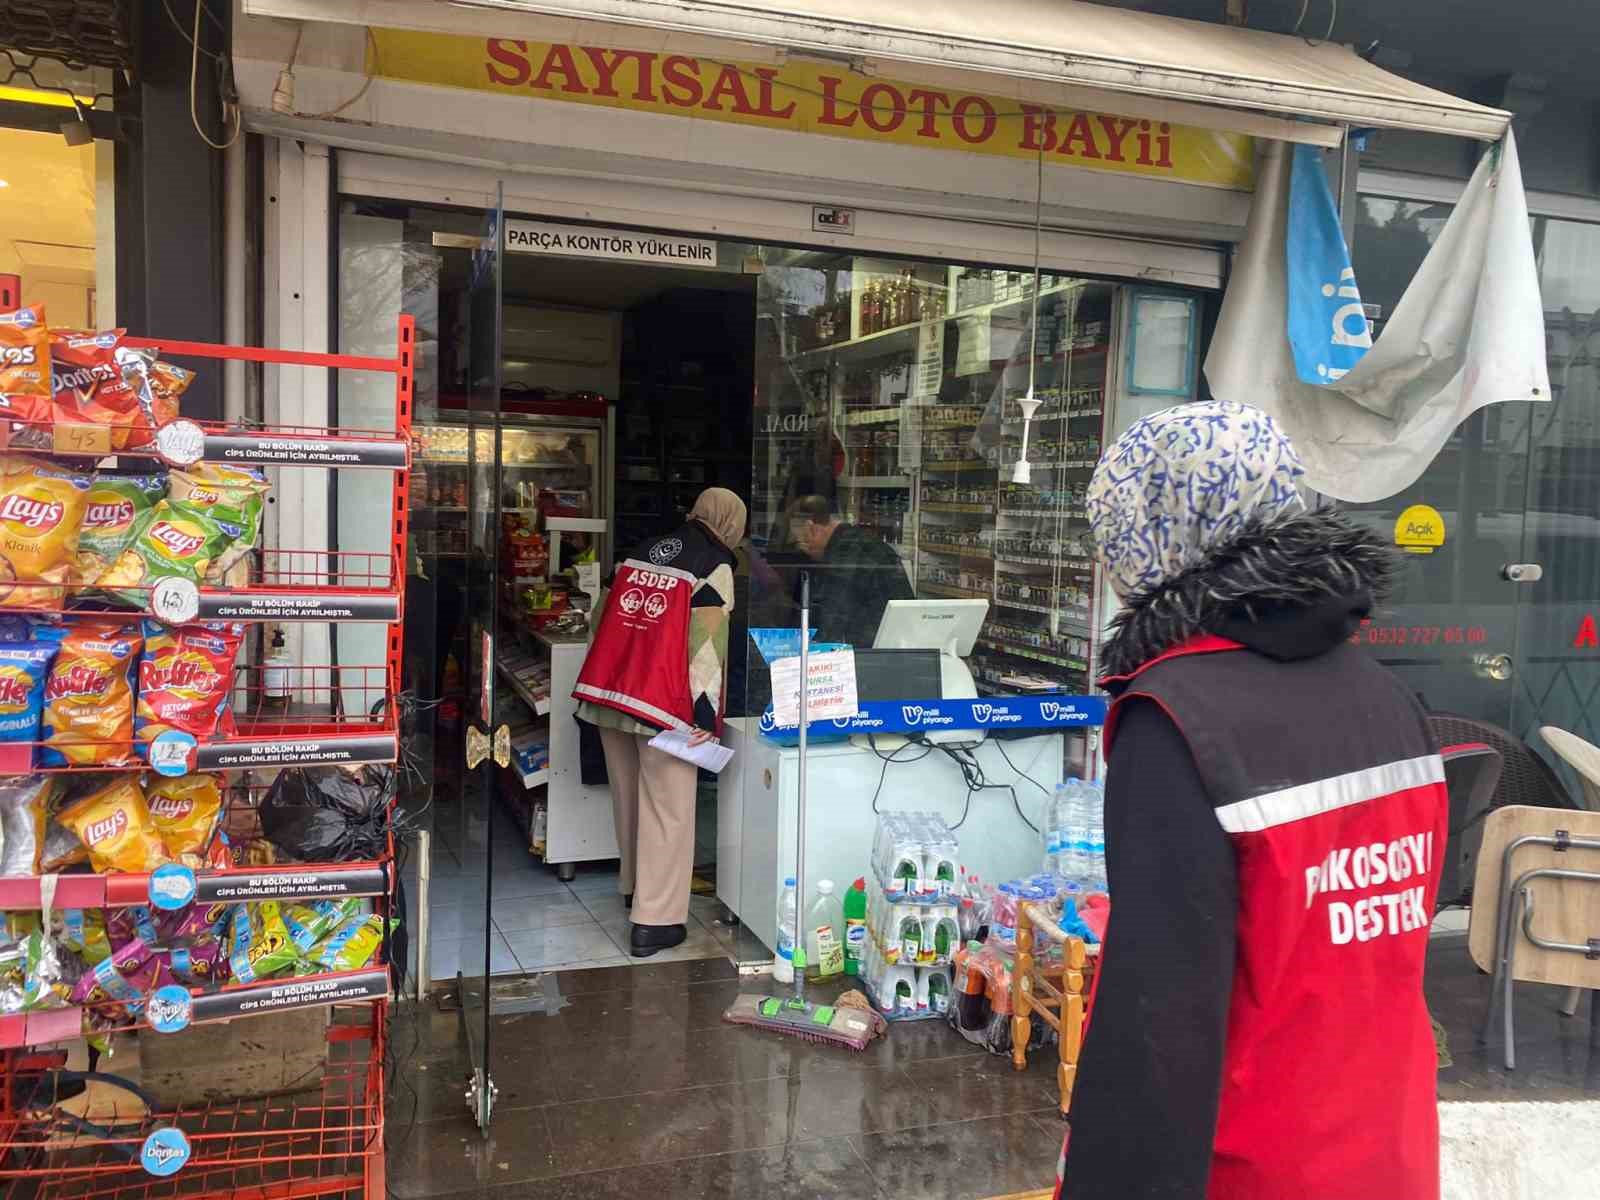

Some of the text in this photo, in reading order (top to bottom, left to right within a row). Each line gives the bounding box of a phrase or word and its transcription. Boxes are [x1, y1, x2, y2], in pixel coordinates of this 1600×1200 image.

[485, 37, 797, 120] SAYISAL
[817, 75, 997, 145] LOTO
[508, 229, 712, 261] PARÇA KONTÖR YÜKLENİR
[258, 442, 271, 450] BU
[273, 442, 302, 451] BÖLÜM
[224, 449, 244, 458] CİPS
[290, 451, 307, 461] İÇİN
[1, 495, 63, 528] Lay's
[151, 524, 204, 554] Lay's
[5, 540, 41, 554] Klasik
[627, 569, 678, 590] ASDEP
[251, 599, 264, 607] BU
[264, 599, 294, 608] BÖLÜM
[218, 607, 237, 616] CİPS
[239, 607, 281, 616] ÜRÜNLERİ
[282, 608, 299, 617] İÇİN
[1060, 705, 1075, 713] milli
[923, 716, 954, 725] piyango
[993, 714, 1022, 722] piyango
[1060, 712, 1088, 721] piyango
[852, 719, 883, 728] piyango
[251, 747, 264, 755] BU
[264, 745, 294, 754] BÖLÜM
[219, 756, 237, 764] CİPS
[282, 753, 299, 762] İÇİN
[249, 879, 262, 887] BU
[263, 877, 292, 887] BÖLÜM
[216, 888, 235, 897] CİPS
[236, 886, 278, 896] ÜRÜNLERİ
[279, 885, 296, 895] İÇİN
[1328, 885, 1429, 945] DESTEK
[272, 989, 283, 998] BU
[240, 1002, 258, 1011] CİPS
[301, 993, 317, 1003] İÇİN
